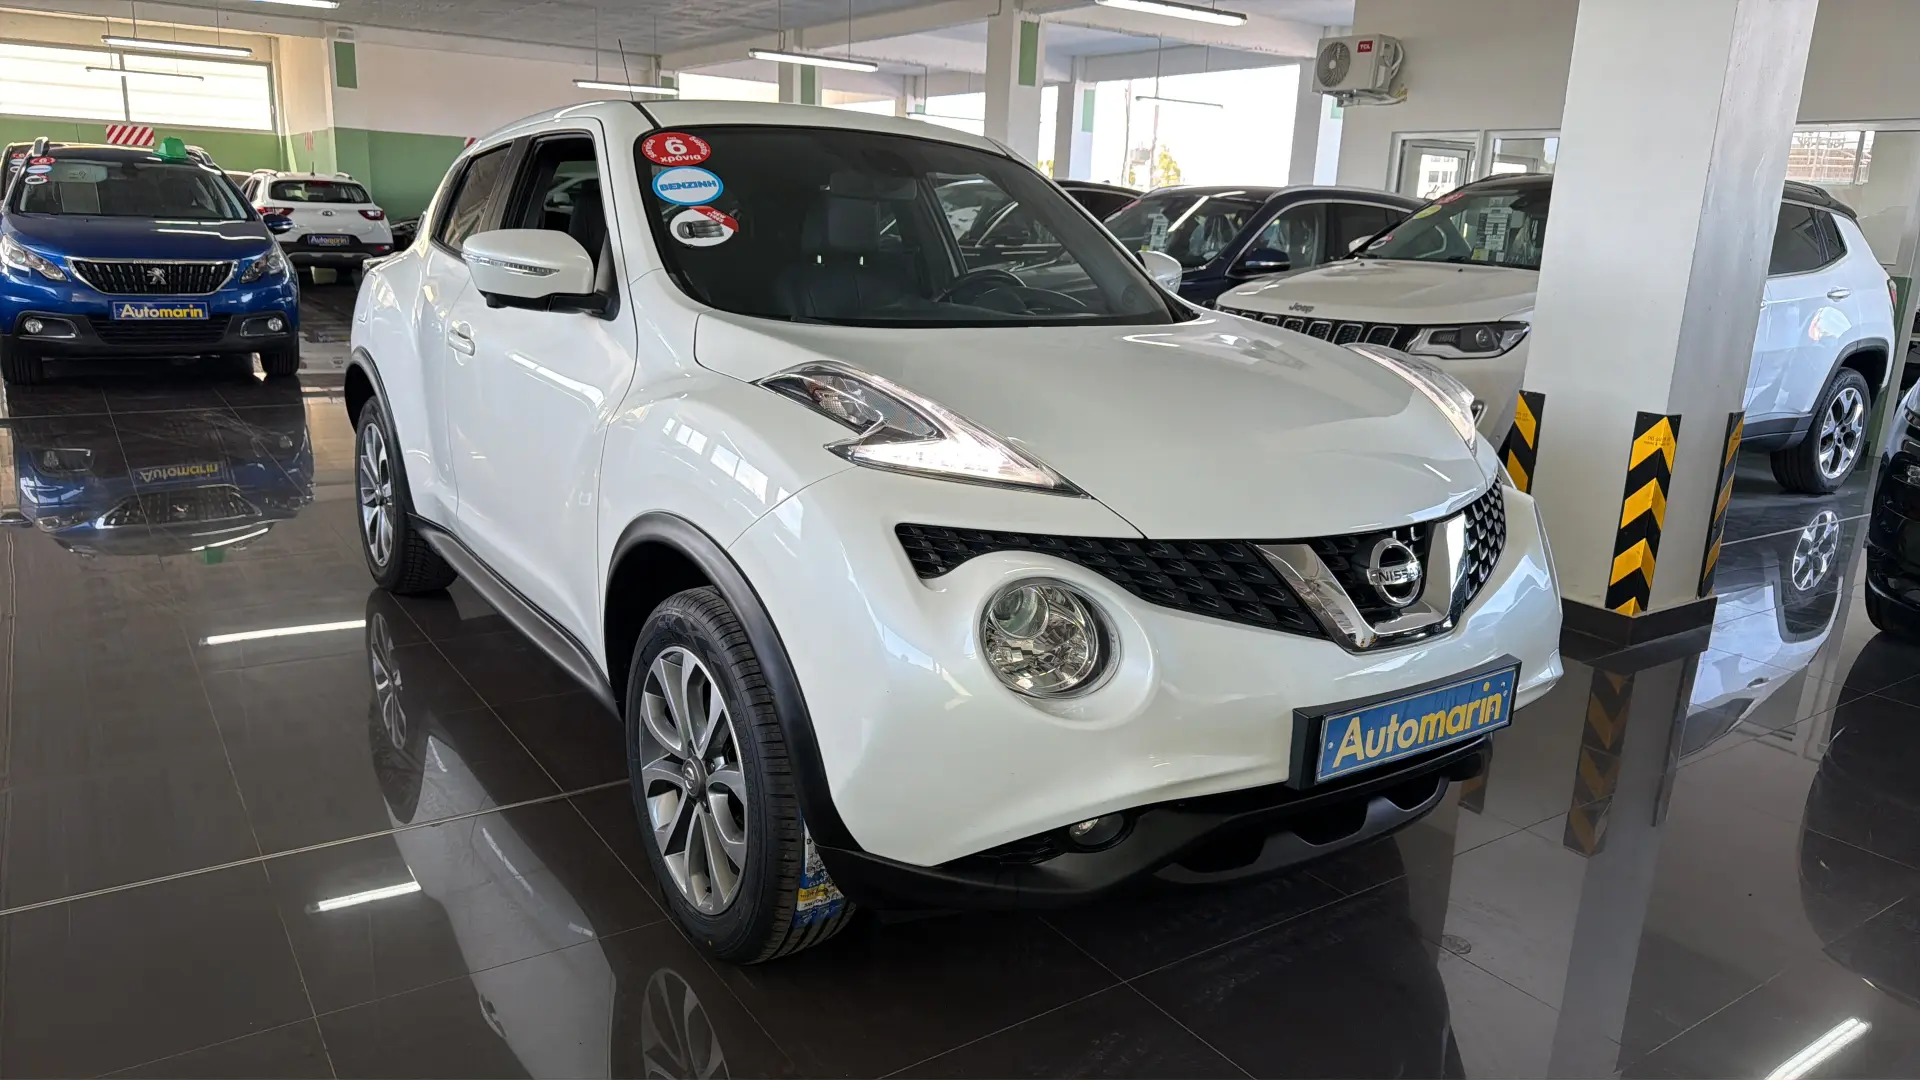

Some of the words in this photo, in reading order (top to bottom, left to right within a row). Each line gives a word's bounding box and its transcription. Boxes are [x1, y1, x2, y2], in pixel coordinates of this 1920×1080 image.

[664, 139, 688, 155] 6
[660, 154, 702, 163] χρόνια
[120, 303, 203, 318] Automarin
[1289, 302, 1314, 314] Jeep
[1332, 681, 1502, 769] Automarin
